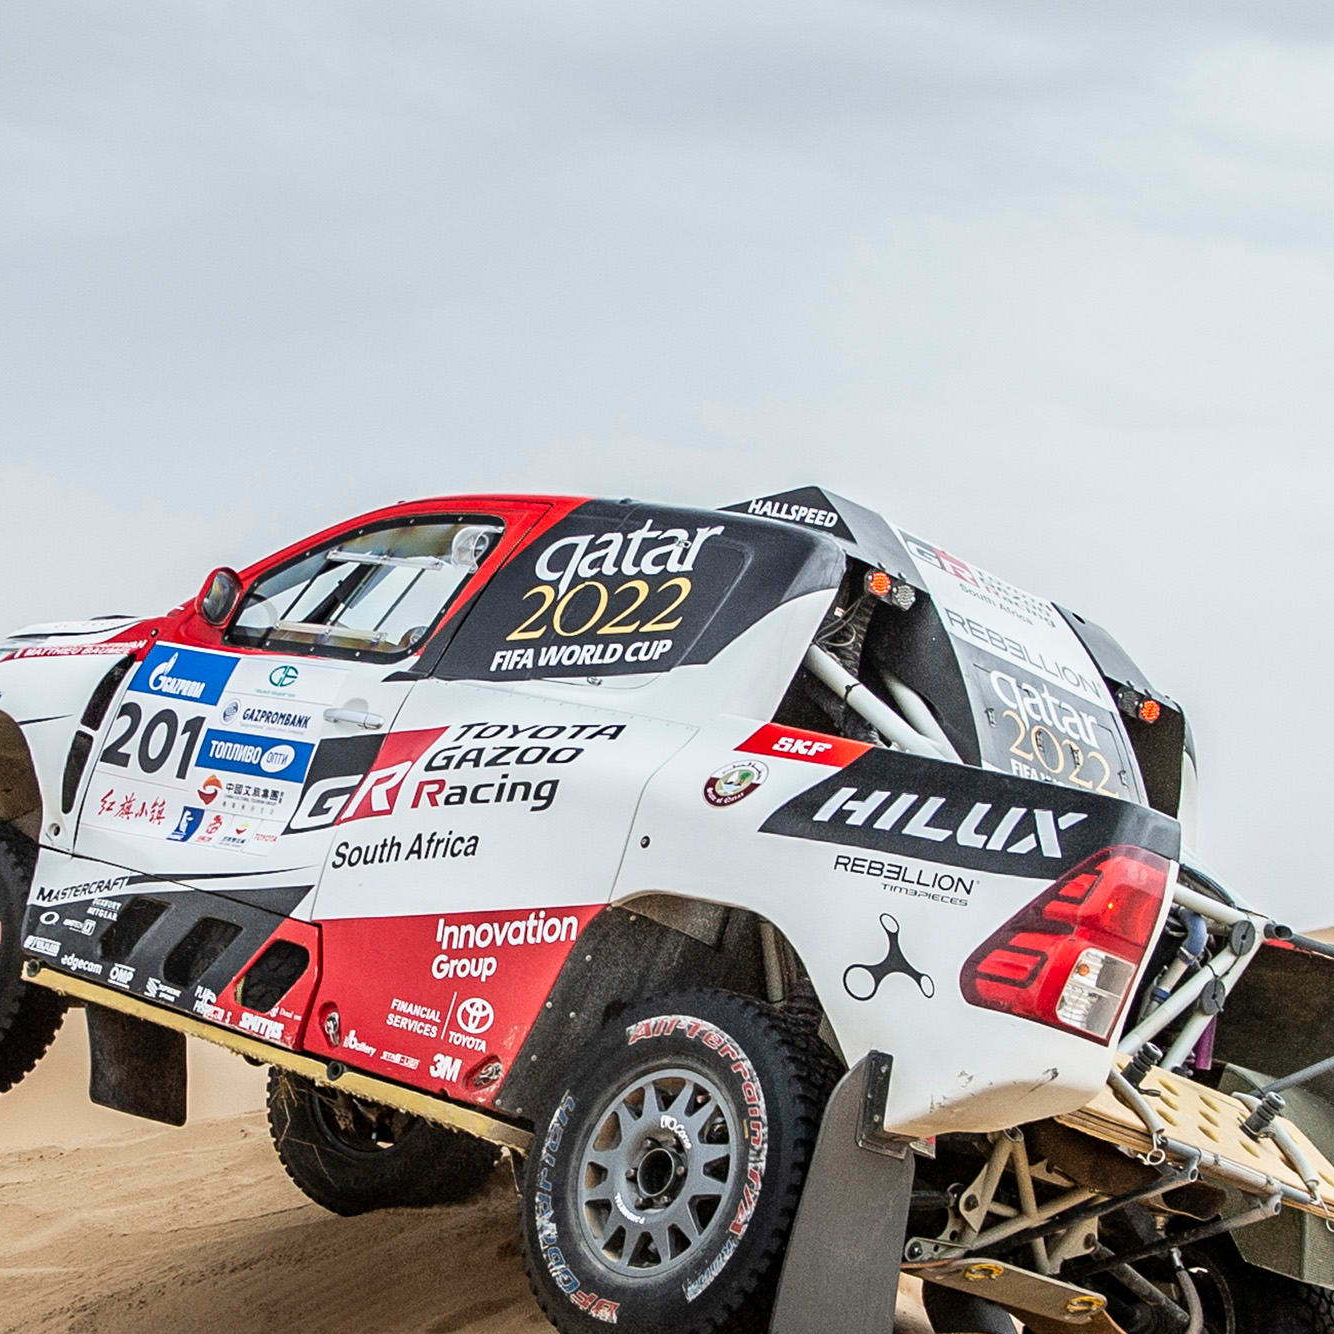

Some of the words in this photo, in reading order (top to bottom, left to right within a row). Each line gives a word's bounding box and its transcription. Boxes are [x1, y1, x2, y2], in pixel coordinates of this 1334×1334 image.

[747, 499, 838, 528] HALLSPEED
[535, 519, 725, 600] qatar
[505, 577, 692, 641] 2022
[489, 653, 536, 672] FIFA
[538, 644, 621, 668] WORLD
[623, 639, 672, 662] CUP
[242, 707, 312, 729] GAZPROMBANK
[990, 670, 1100, 749] qatar
[100, 702, 207, 780] 201
[455, 722, 627, 743] TOYOTA
[771, 736, 832, 756] SKF
[208, 740, 263, 765] ТОПЛИВО
[424, 745, 585, 773] GAZOO
[1002, 709, 1119, 797] 2022
[411, 774, 560, 812] Racing
[812, 787, 1087, 859] HILUX
[332, 837, 402, 869] South
[405, 831, 480, 862] Africa
[36, 877, 129, 902] MASTERCRAFT
[436, 910, 579, 949] Innovation
[431, 954, 497, 982] Group
[390, 998, 442, 1023] FINANCIAL
[386, 1013, 438, 1039] SERVICES
[448, 1030, 487, 1053] TOYOTA
[429, 1053, 463, 1083] 3M
[627, 1017, 765, 1147] All-Terrain
